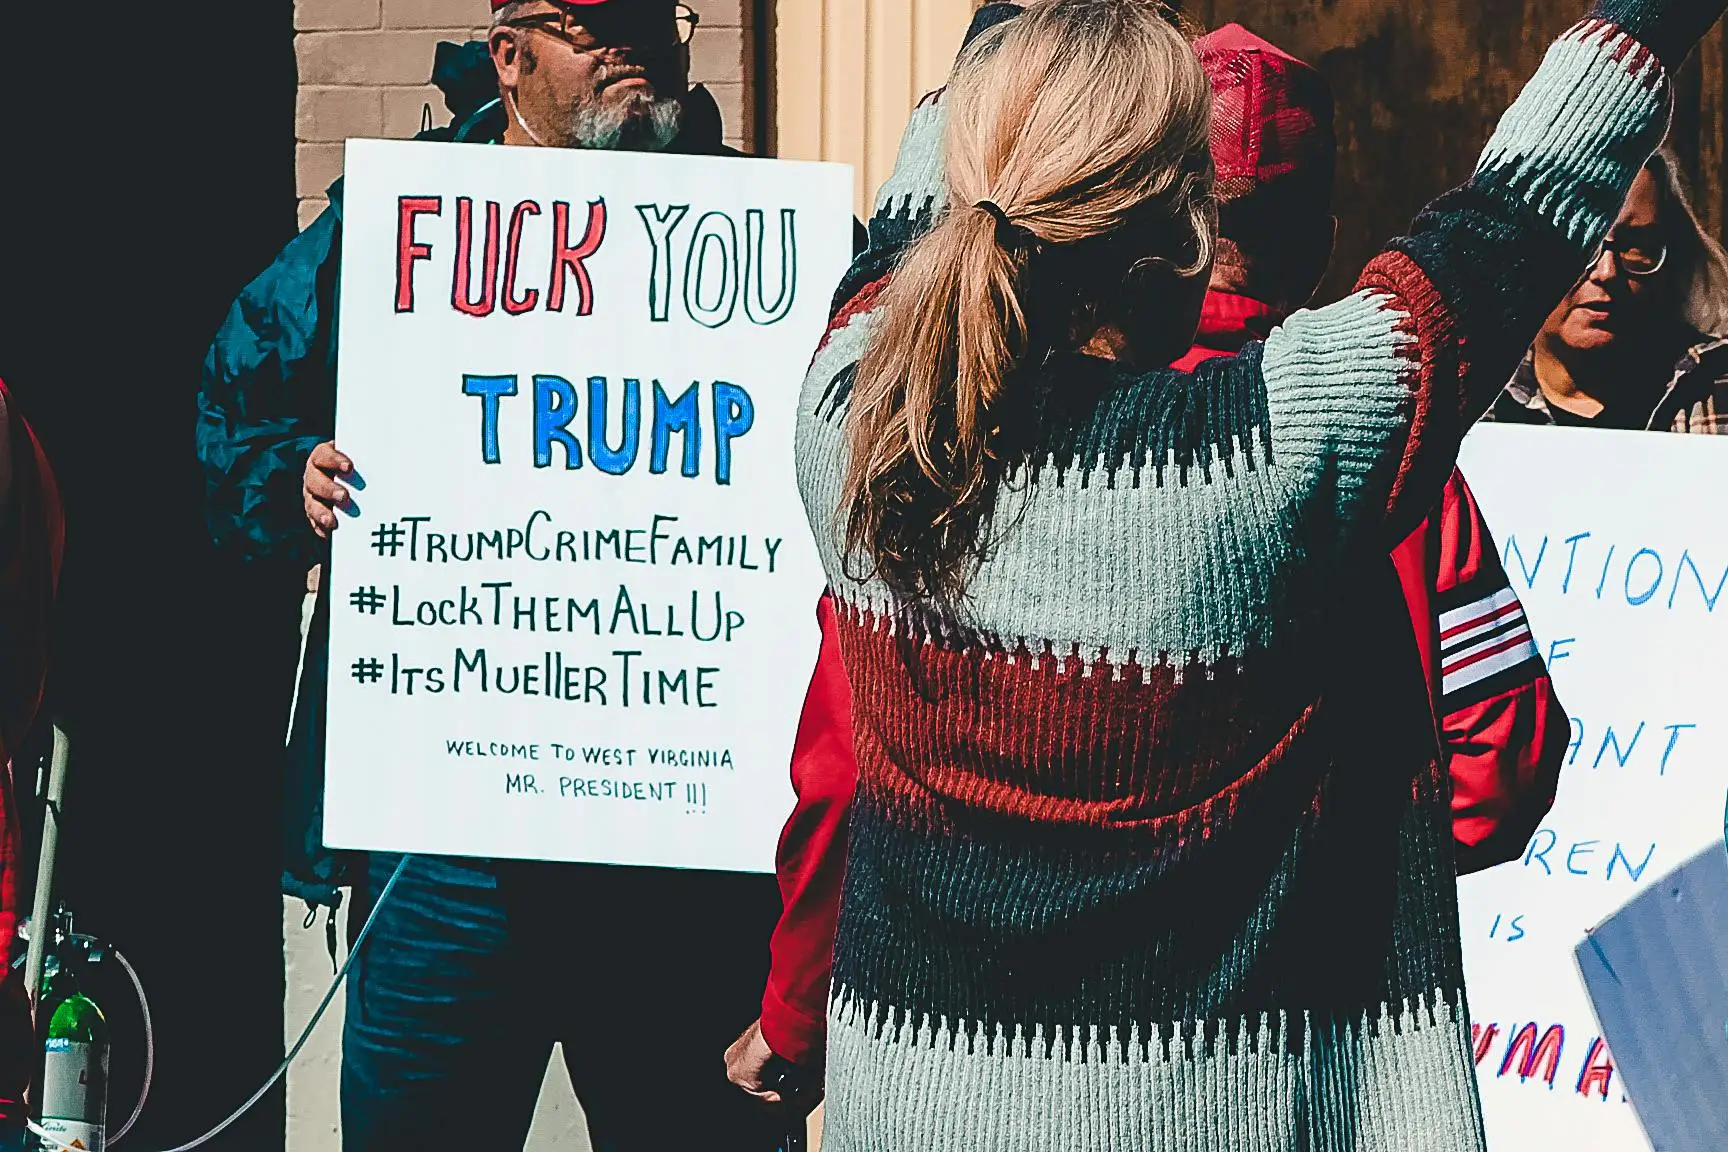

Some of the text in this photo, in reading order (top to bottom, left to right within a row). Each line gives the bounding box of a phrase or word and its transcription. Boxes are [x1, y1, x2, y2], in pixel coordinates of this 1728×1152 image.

[394, 194, 796, 328] FUCK YOU
[461, 373, 755, 485] TRUMP
[446, 740, 734, 770] WELCOME TO WEST VIRGINIA
[506, 773, 545, 794] MR.
[559, 777, 677, 801] PRESIDENT
[1524, 829, 1655, 881] REN
[1489, 914, 1525, 942] IS
